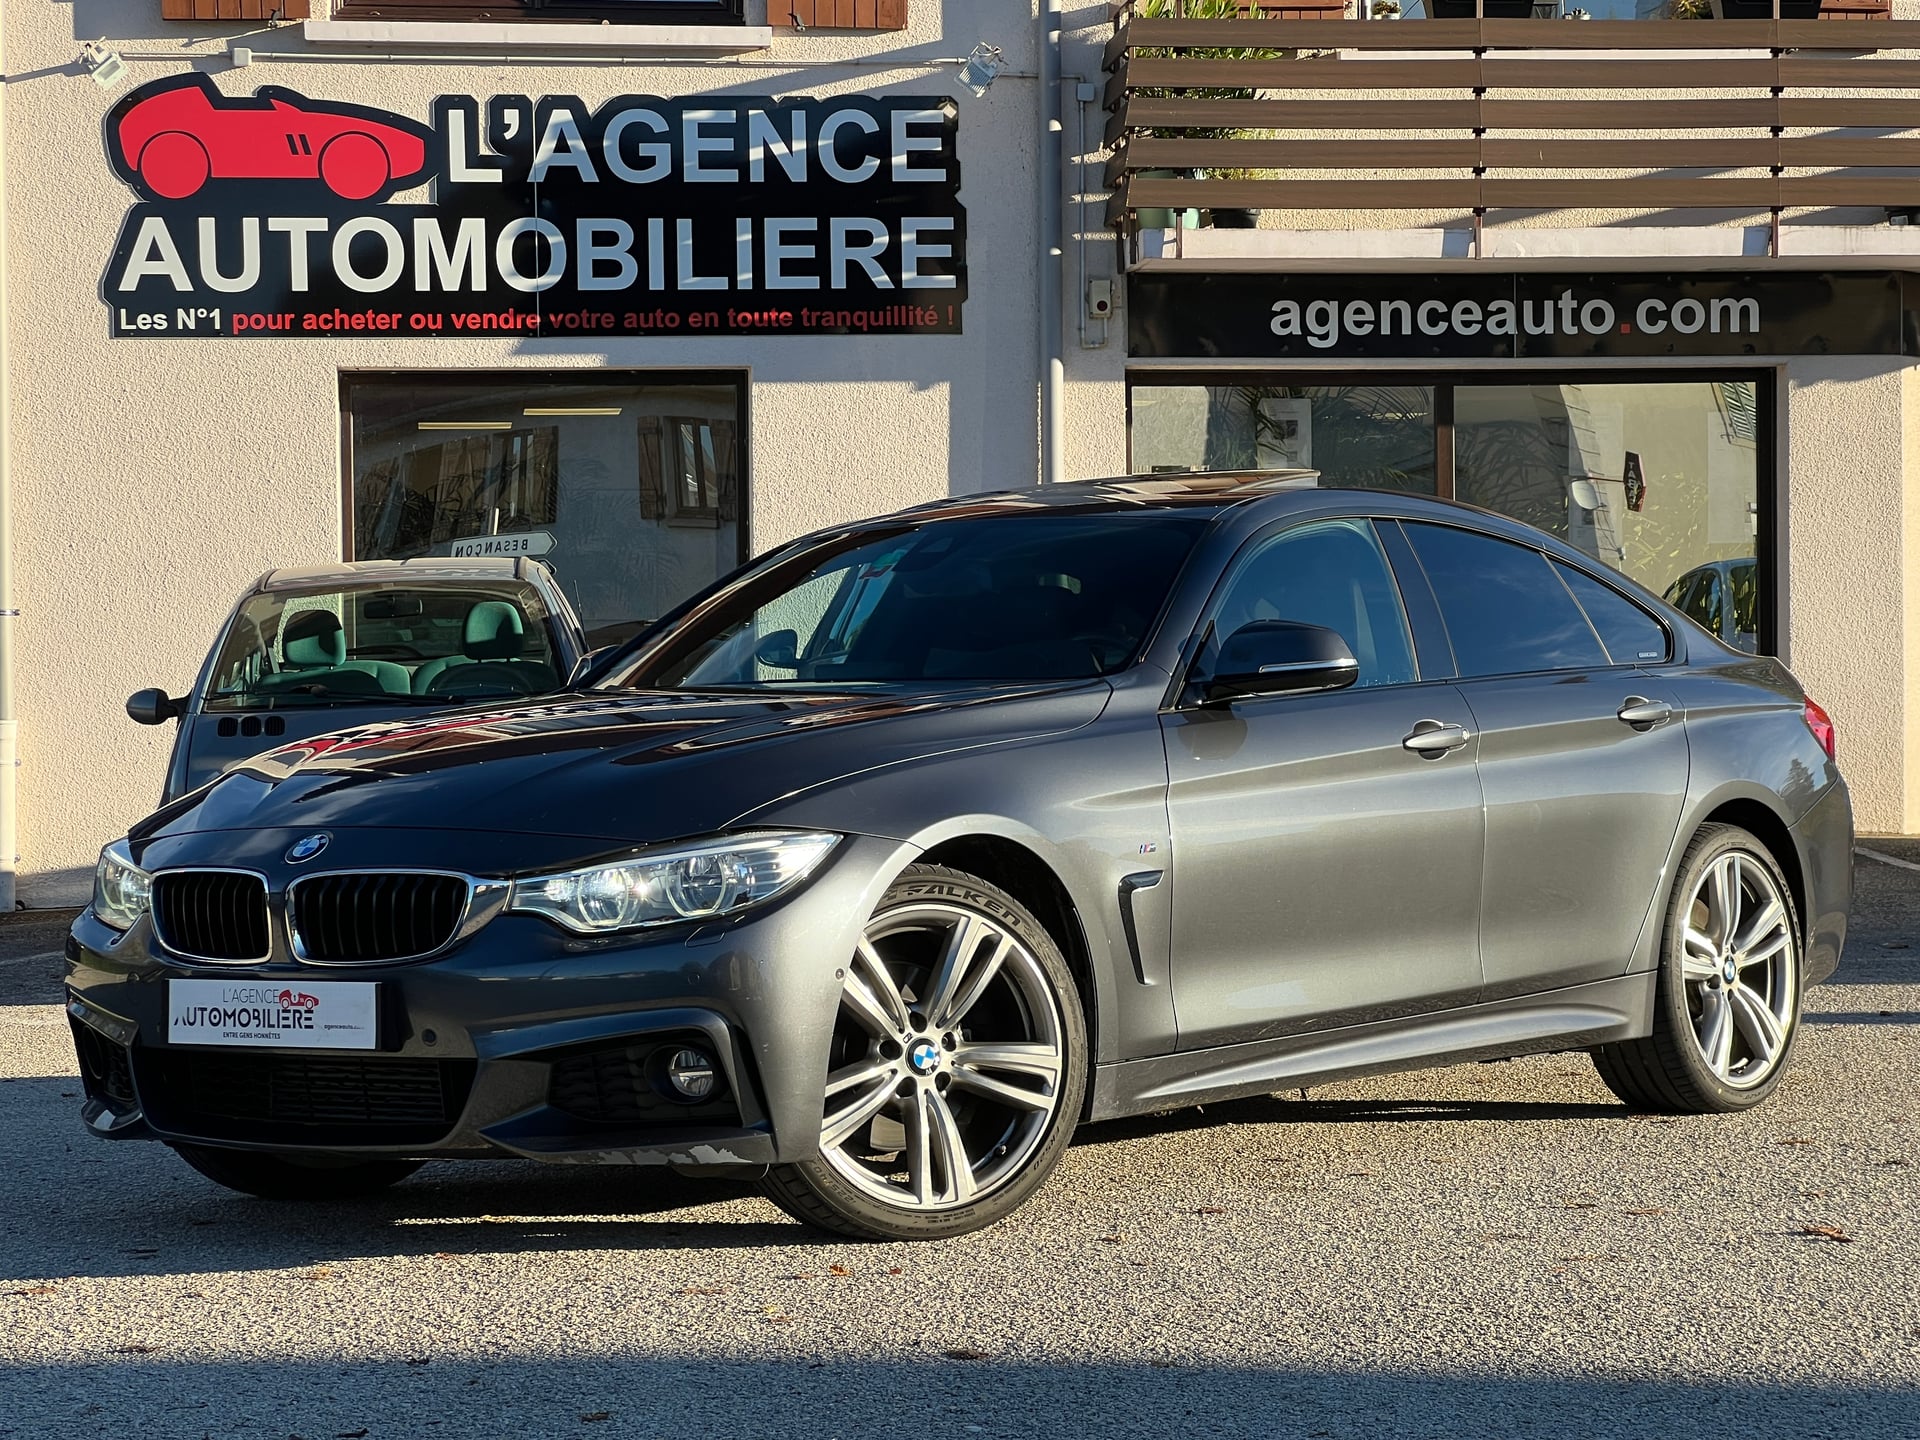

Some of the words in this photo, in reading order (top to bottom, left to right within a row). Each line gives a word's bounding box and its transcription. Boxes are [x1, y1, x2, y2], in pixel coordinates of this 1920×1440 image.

[448, 108, 947, 184] L'AGENCE
[118, 216, 957, 293] AUTOMOBILIERE
[120, 308, 168, 330] Les
[177, 307, 222, 330] N°1
[232, 313, 295, 335] pour
[303, 308, 402, 330] acheter
[410, 313, 442, 330] ou
[450, 307, 541, 330] vendre
[549, 309, 615, 329] votre
[623, 309, 681, 329] auto
[688, 312, 719, 329] en
[727, 309, 793, 328] toute
[801, 305, 938, 332] tranquillité
[947, 306, 954, 327] !
[1270, 289, 1760, 349] agenceauto.com
[902, 884, 1022, 927] FALKEN
[222, 988, 279, 1004] L'AGENCE
[222, 1031, 239, 1039] ENTRE
